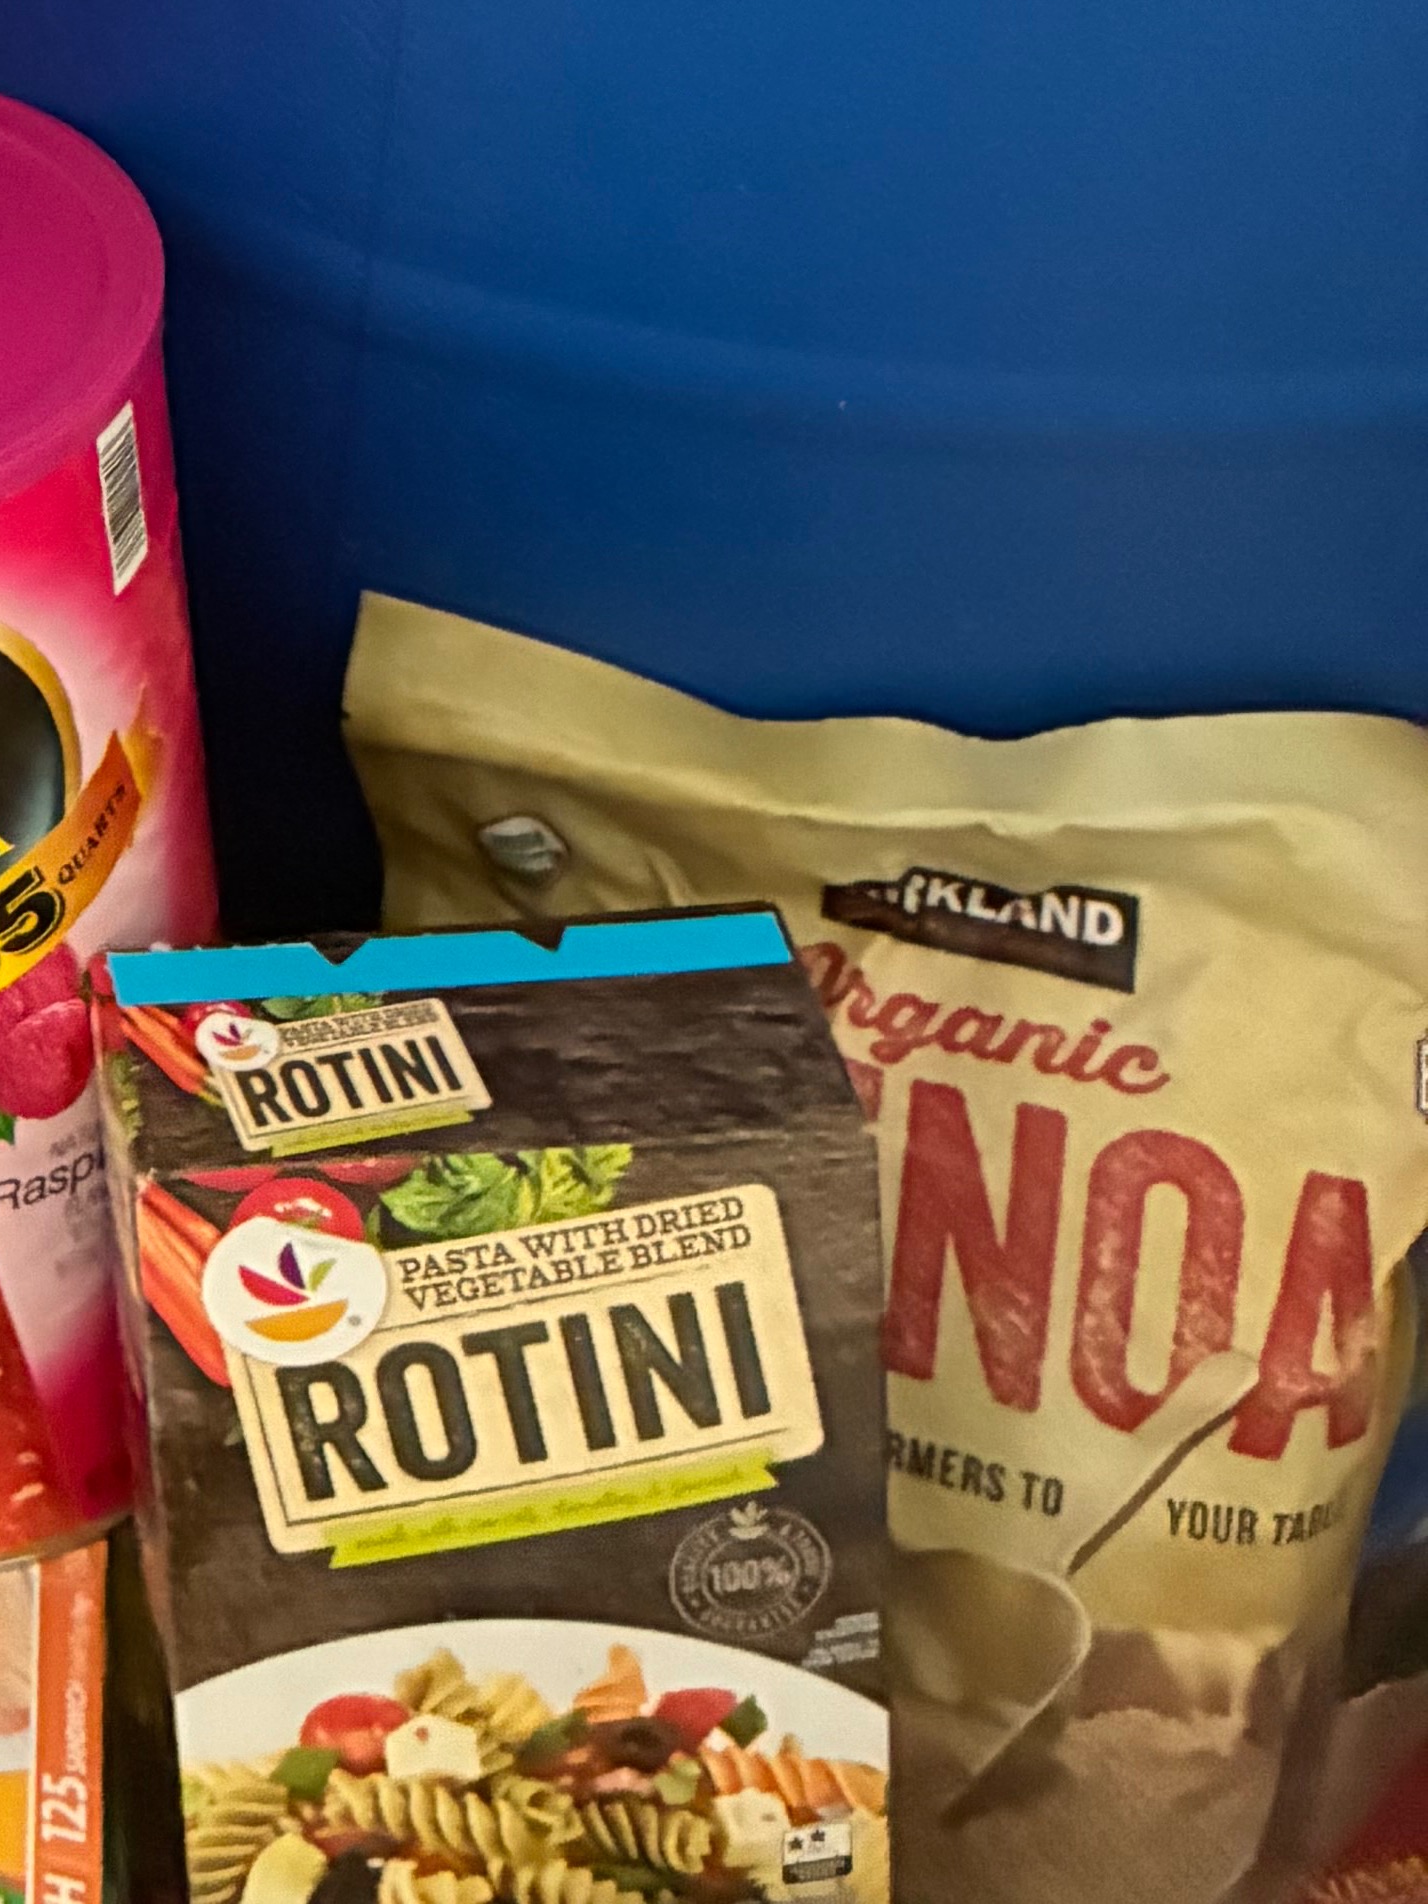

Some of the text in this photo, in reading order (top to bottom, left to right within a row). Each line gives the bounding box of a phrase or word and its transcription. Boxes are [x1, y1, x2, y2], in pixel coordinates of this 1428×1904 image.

[57, 784, 126, 886] QUARTS
[235, 1035, 463, 1127] ROTINI
[397, 1196, 744, 1284] PASTA WITH DRIED
[404, 1223, 752, 1311] VEGETABLE BLEND
[846, 1059, 1376, 1461] NOA
[275, 1280, 772, 1502] ROTINI
[888, 1430, 1006, 1503] RMERS
[1020, 1469, 1065, 1517] TO
[1167, 1497, 1258, 1545] YOUR
[710, 1556, 792, 1595] 100%
[40, 1771, 87, 1842] 125
